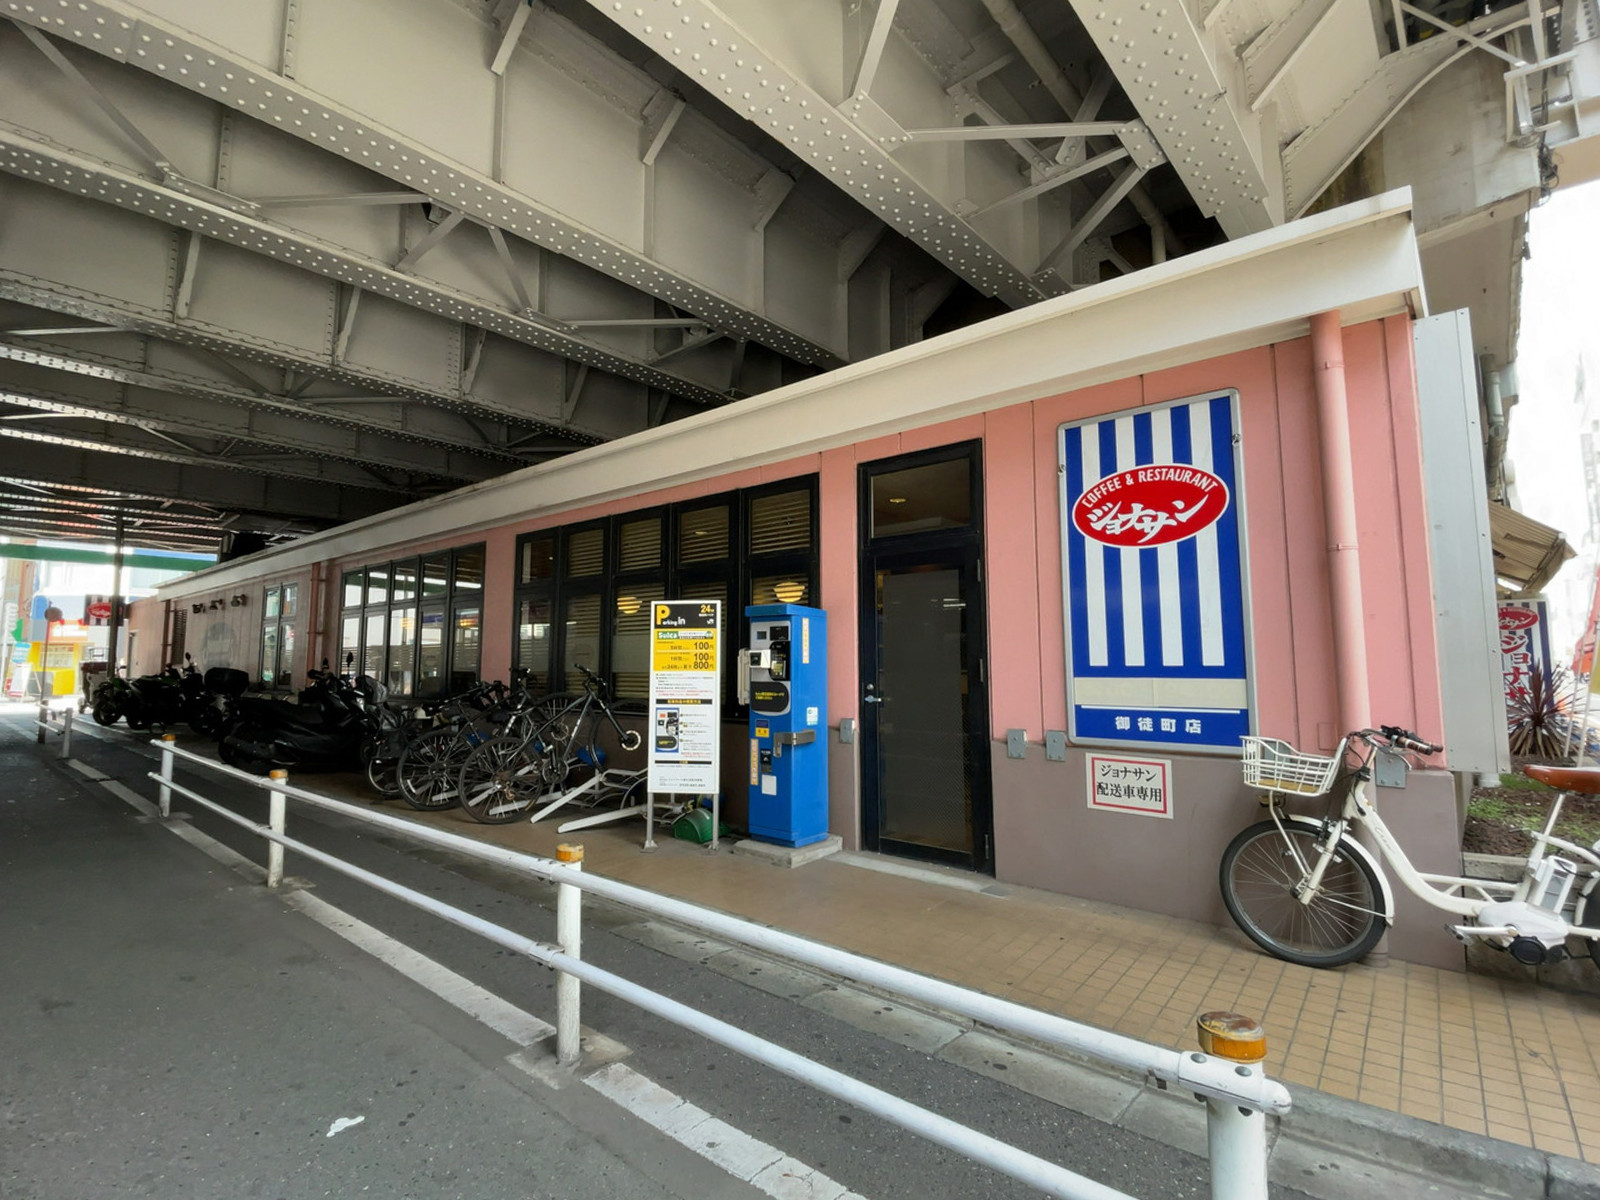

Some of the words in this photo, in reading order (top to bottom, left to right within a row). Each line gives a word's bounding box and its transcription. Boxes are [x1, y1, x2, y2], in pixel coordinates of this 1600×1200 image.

[1081, 477, 1122, 508] COFFEE
[1125, 473, 1134, 486] &
[1138, 468, 1218, 493] RESTAURANT
[1086, 494, 1209, 543] ジョナサン
[658, 631, 678, 640] Suica
[1115, 716, 1201, 734] 御徒町店
[1100, 764, 1157, 782] ジョナサン
[1096, 781, 1162, 803] 配送車専用
